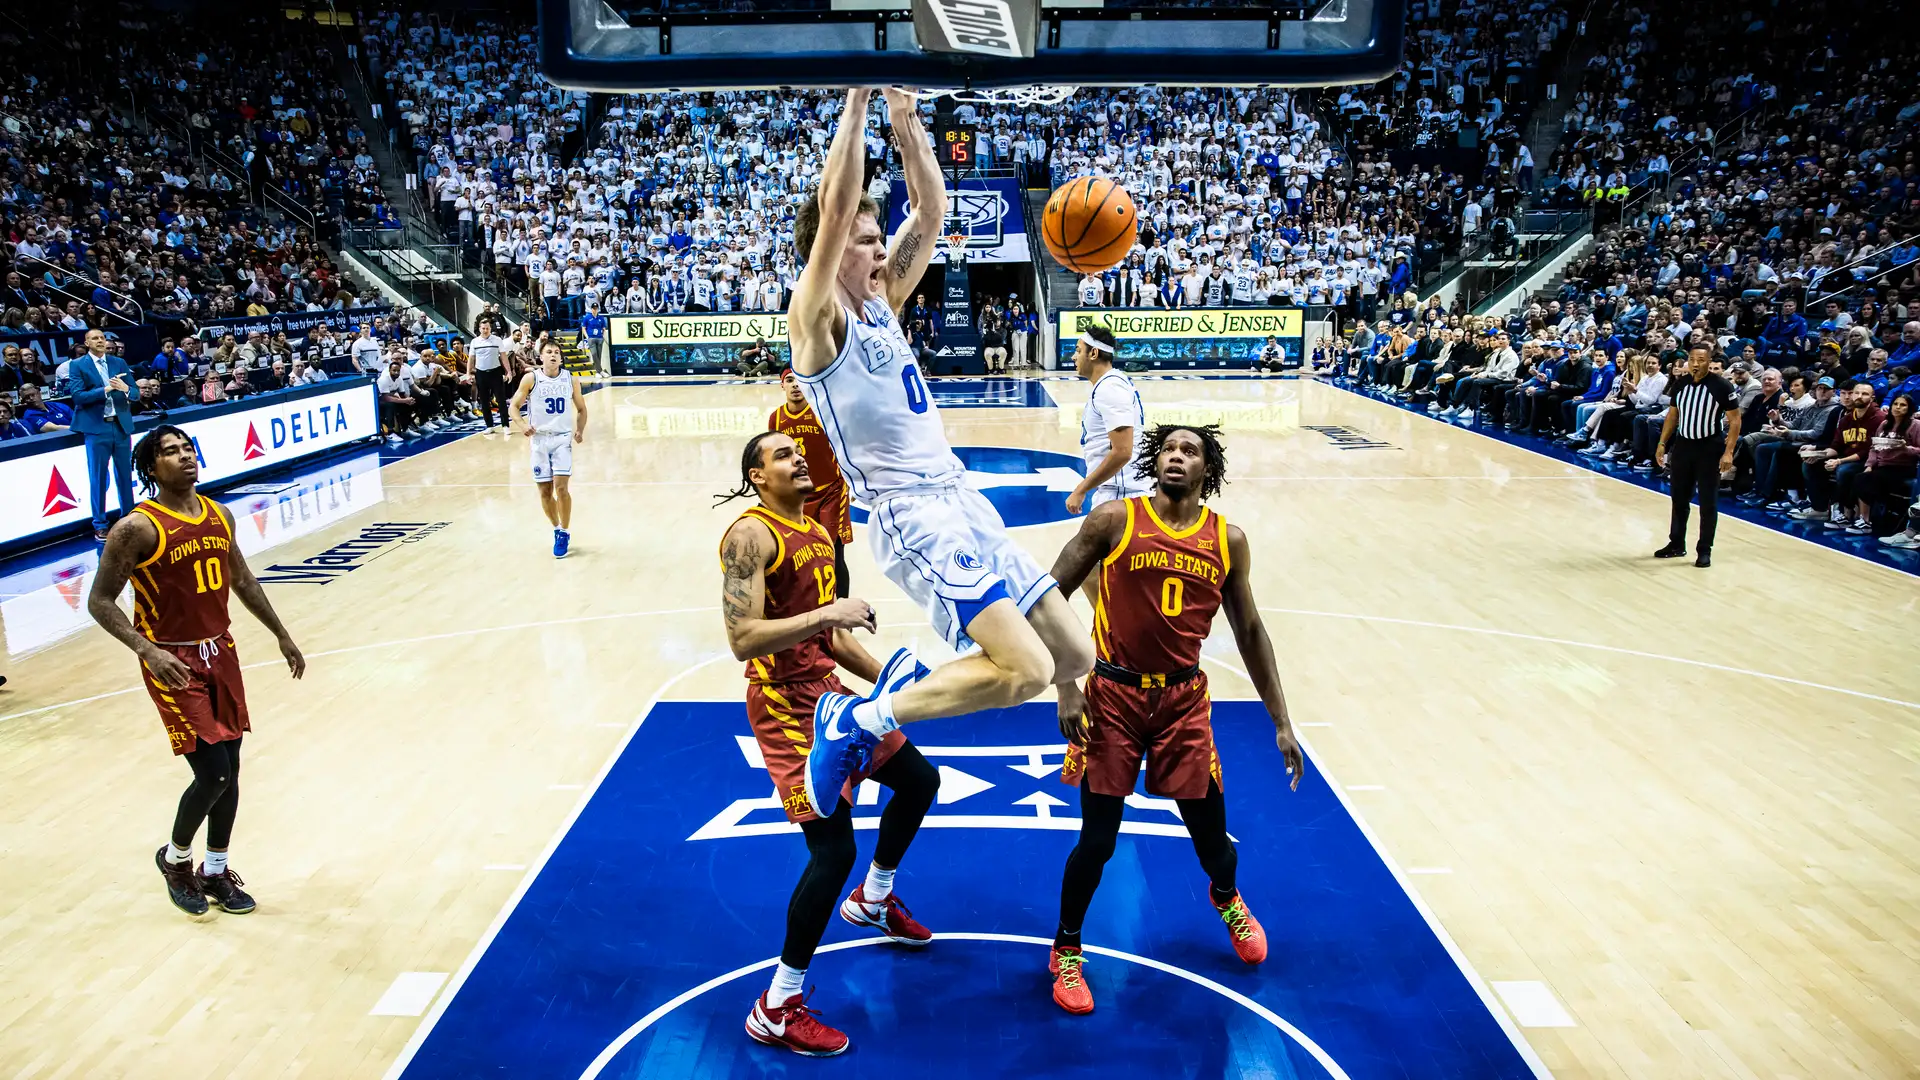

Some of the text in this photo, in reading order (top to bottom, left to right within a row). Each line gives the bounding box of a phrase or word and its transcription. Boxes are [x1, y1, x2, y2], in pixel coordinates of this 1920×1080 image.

[952, 143, 967, 161] 15
[653, 319, 742, 338] SIEGFRIED
[746, 318, 764, 337] &
[1103, 312, 1287, 335] SIEGFRIED & JENSEN
[901, 364, 928, 414] 0
[545, 397, 565, 414] 30
[271, 403, 348, 449] DELTA
[796, 425, 820, 435] STATE
[170, 538, 201, 564] IOWA
[256, 522, 429, 585] Marriott
[792, 545, 815, 571] IOWA
[194, 557, 223, 594] 10
[1129, 551, 1220, 585] IOWA STATE
[813, 565, 836, 605] 12
[1161, 577, 1184, 617] 0
[783, 792, 811, 811] STAT
